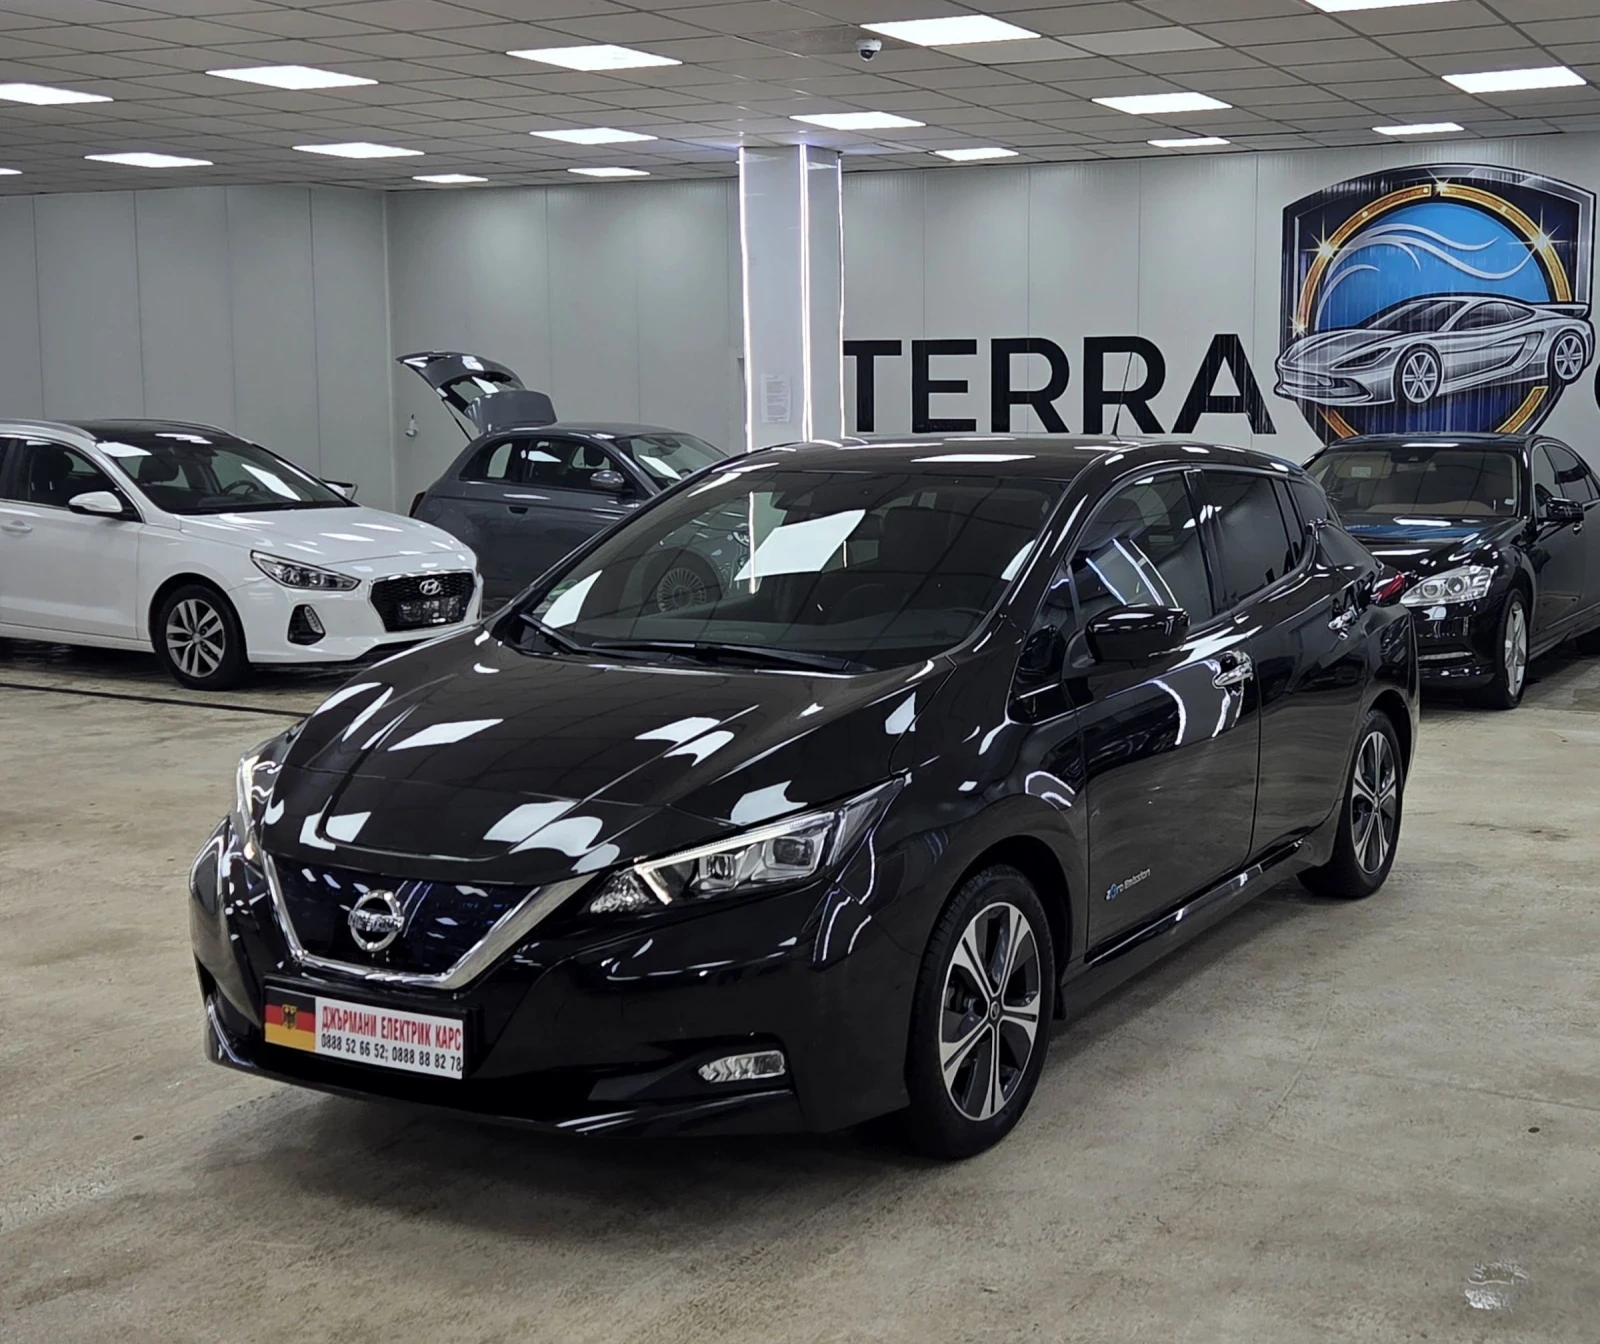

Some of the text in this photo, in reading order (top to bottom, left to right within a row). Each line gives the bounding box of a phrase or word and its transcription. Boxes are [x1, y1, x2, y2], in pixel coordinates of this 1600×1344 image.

[843, 333, 1277, 434] TERRA
[321, 1005, 462, 1051] ДЖЪРМАНИ ЕЛЕКТРИК КАРС
[321, 1033, 463, 1073] 0888 52 66 52; 0888 88 82 78
